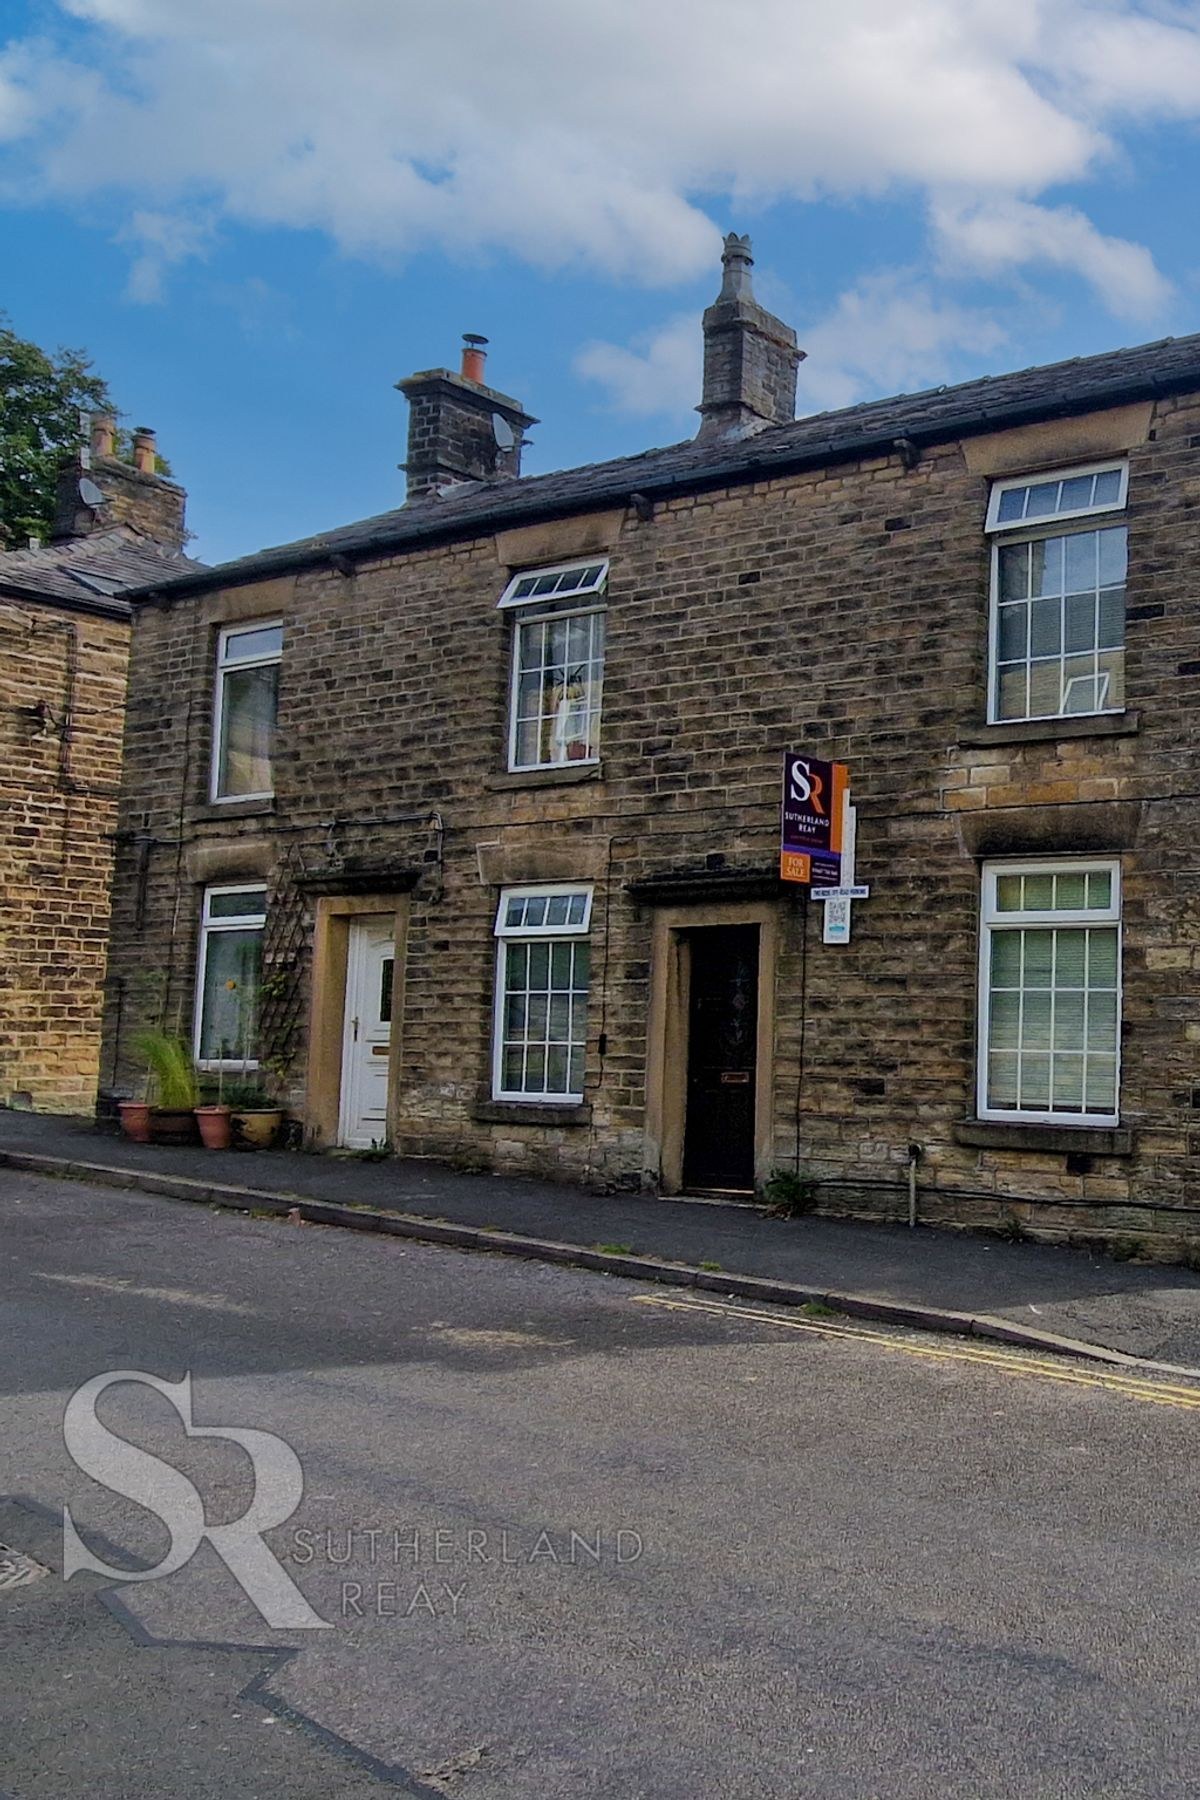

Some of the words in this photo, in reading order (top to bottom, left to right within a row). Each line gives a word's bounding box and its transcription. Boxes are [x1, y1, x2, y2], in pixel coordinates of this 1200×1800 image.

[791, 760, 825, 814] SR
[785, 811, 830, 827] SUTHERLAND
[798, 823, 817, 834] REAY
[787, 856, 804, 868] FOR
[785, 867, 806, 878] SALE
